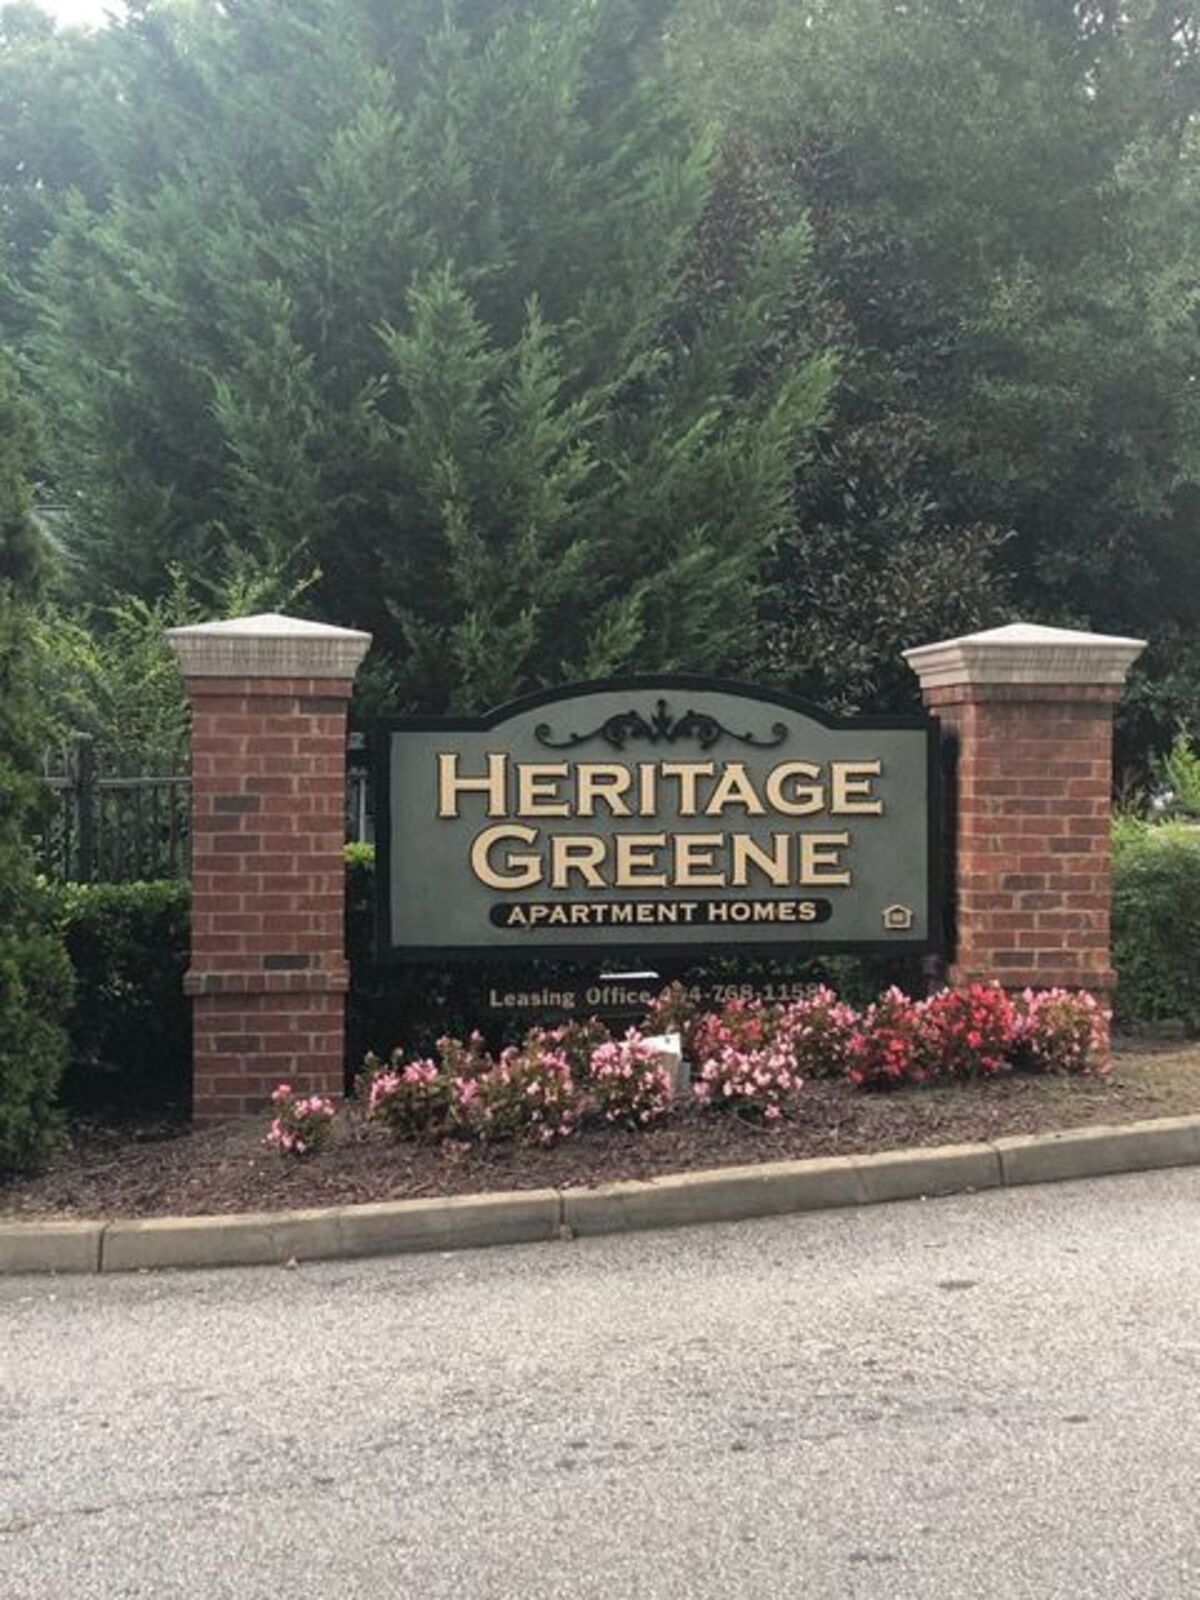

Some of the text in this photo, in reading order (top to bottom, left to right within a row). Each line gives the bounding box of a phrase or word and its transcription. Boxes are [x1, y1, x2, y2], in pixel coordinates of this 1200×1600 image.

[438, 753, 884, 818] HERITAGE
[470, 824, 852, 890] GREENE
[507, 901, 817, 926] APARTMENT HOMES
[489, 989, 576, 1010] Leasing
[586, 985, 652, 1006] Office
